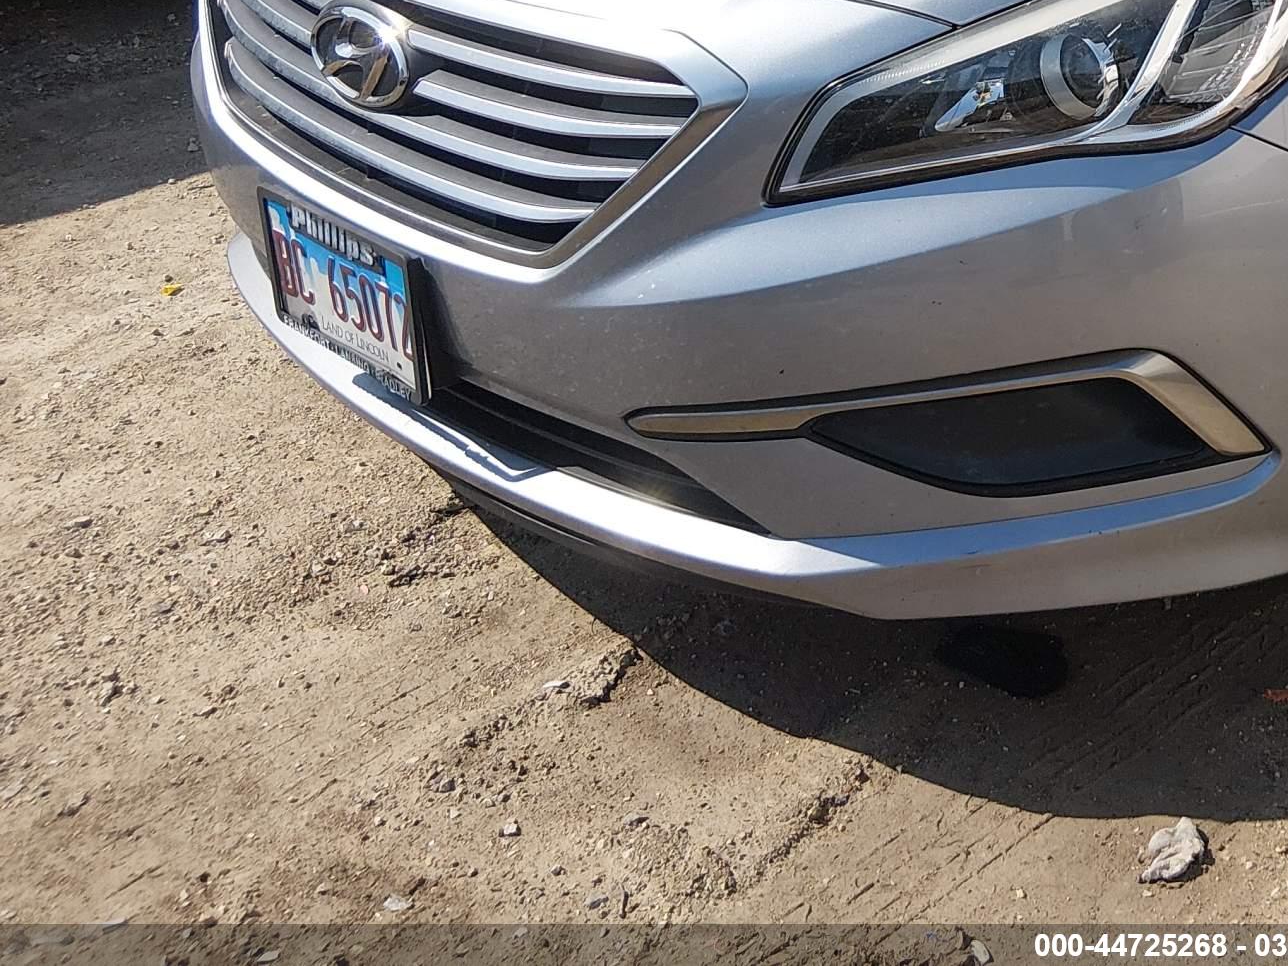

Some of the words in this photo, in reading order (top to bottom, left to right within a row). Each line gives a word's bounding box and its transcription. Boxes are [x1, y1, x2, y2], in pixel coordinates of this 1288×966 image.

[289, 203, 374, 266] Phillips
[272, 228, 316, 306] BC
[321, 313, 343, 339] LAND
